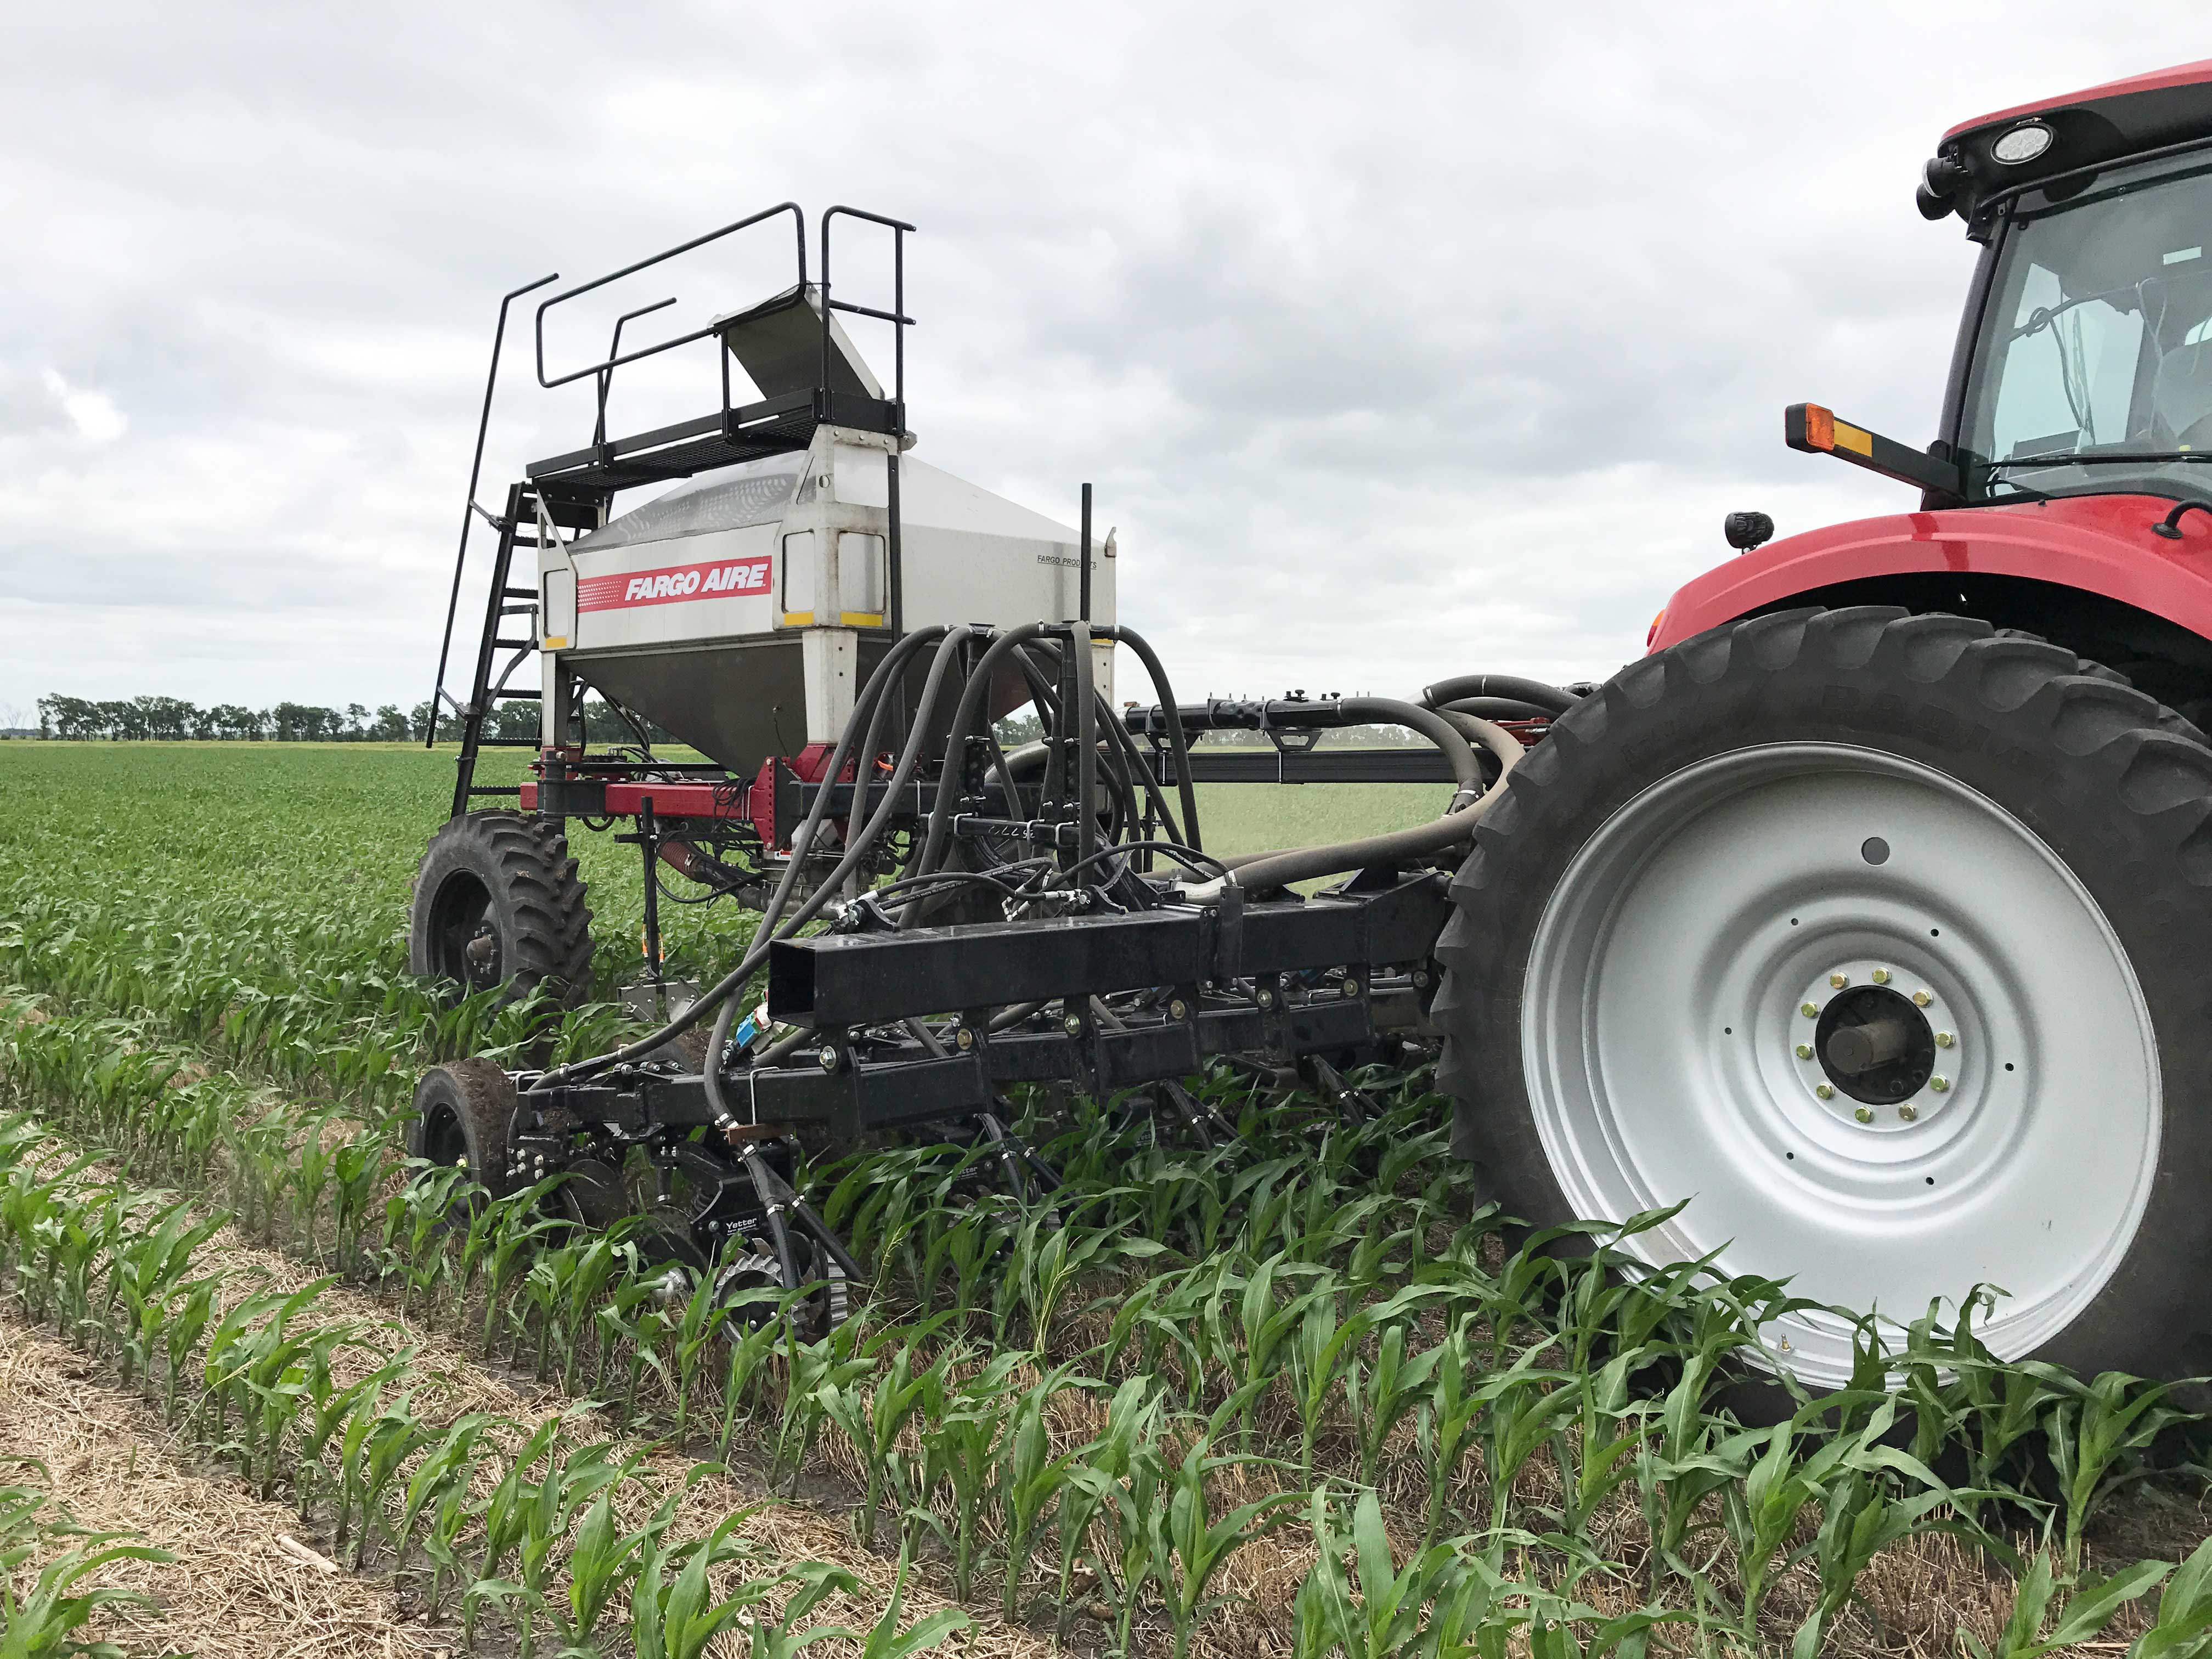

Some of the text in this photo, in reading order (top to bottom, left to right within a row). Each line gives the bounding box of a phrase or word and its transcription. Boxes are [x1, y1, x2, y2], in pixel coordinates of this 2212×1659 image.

[1037, 555, 1097, 568] FARGO PRODTS
[625, 563, 768, 601] FARGO AIRE
[726, 1218, 757, 1229] Yetter
